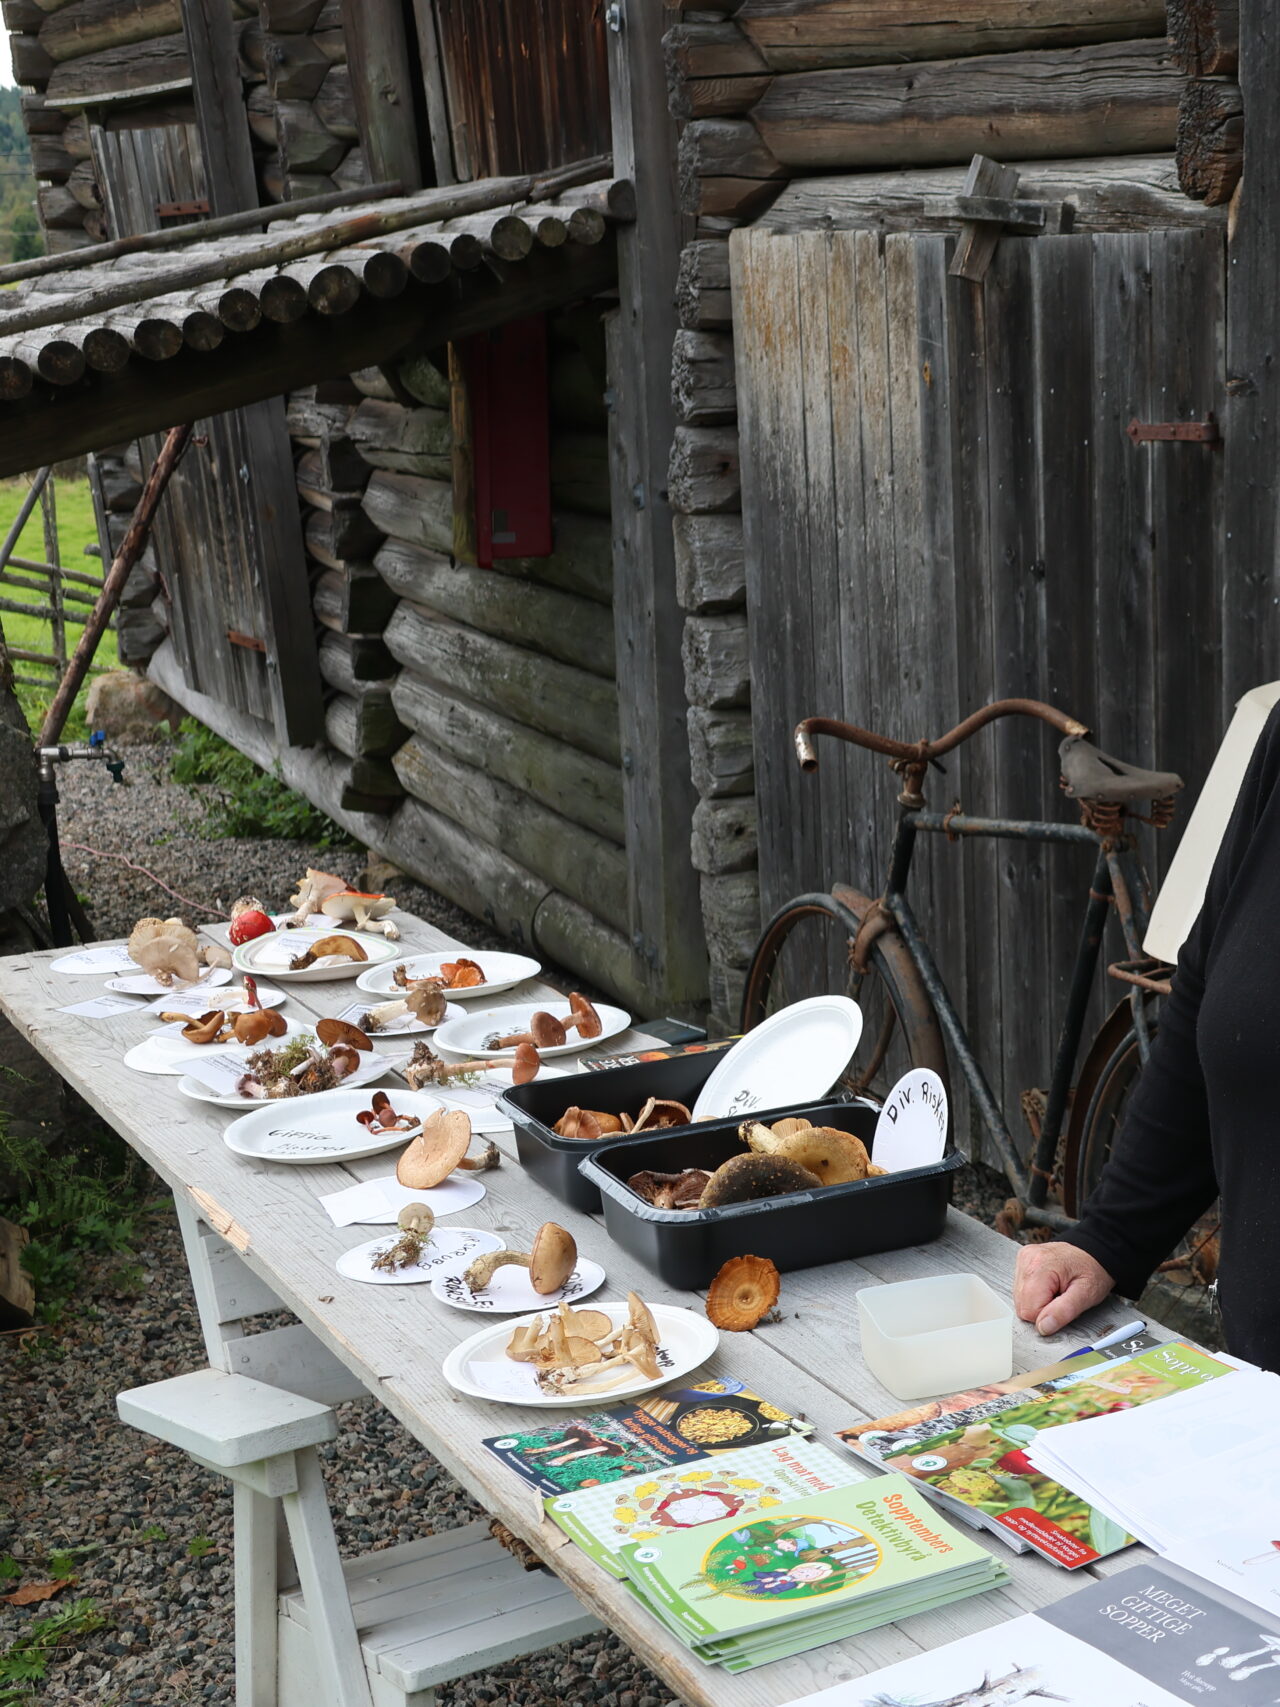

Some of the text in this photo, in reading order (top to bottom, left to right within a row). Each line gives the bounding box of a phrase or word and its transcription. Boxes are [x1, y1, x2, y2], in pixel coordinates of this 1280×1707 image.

[1154, 1350, 1201, 1376] Sopp
[632, 1409, 659, 1430] Trygge
[655, 1423, 691, 1451] matsopper
[641, 1431, 677, 1456] giftsopper
[771, 1446, 835, 1492] Lag mat med
[855, 1500, 933, 1562] Detektivbyrå
[883, 1493, 954, 1554] Sopptembers
[1121, 1595, 1193, 1636] GIFTIGE
[1138, 1585, 1207, 1620] MEGET
[1099, 1604, 1167, 1644] SOPPER
